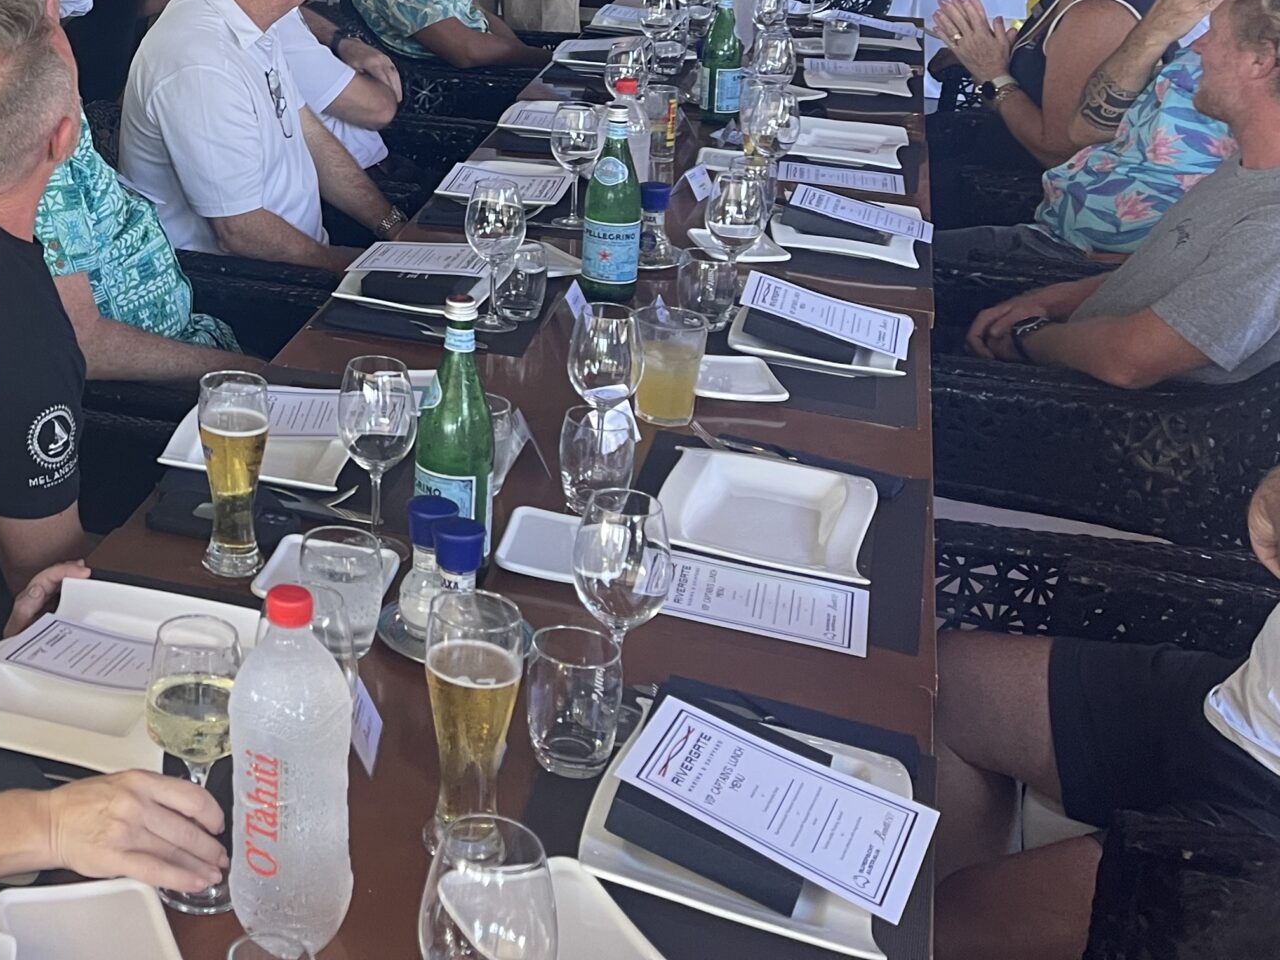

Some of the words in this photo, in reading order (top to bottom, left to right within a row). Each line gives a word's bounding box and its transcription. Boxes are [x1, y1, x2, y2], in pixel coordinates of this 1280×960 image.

[441, 578, 459, 590] AXA
[671, 732, 712, 787] RIVERGATE
[703, 793, 717, 807] VIP
[710, 764, 734, 797] CAPTAIN'S
[727, 745, 745, 768] LUNCH
[728, 773, 746, 793] MENU
[245, 748, 279, 878] O'Tahiti
